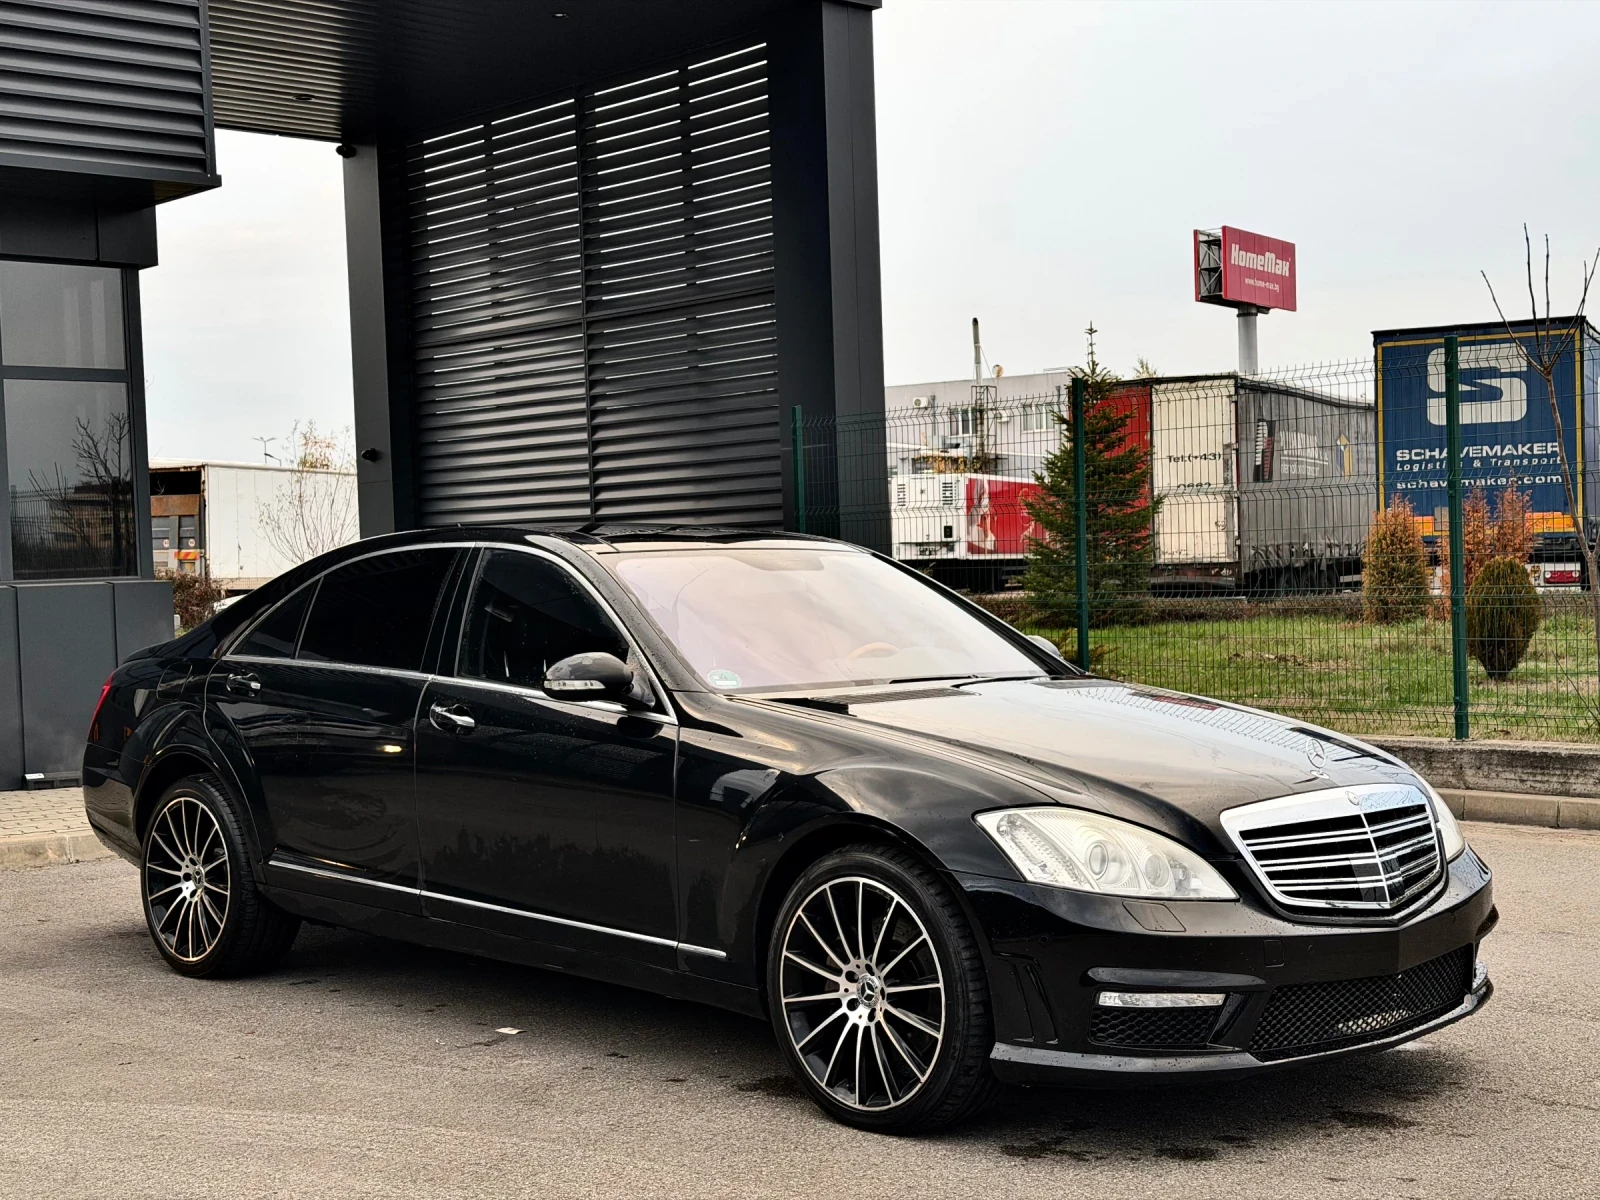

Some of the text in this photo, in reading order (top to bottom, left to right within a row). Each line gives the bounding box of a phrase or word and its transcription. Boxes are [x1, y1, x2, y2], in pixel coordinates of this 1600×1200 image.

[1231, 244, 1289, 277] HomeMax
[1396, 460, 1463, 472] Logisti
[1490, 456, 1562, 467] Transport
[1397, 475, 1563, 489] schavmaker.com
